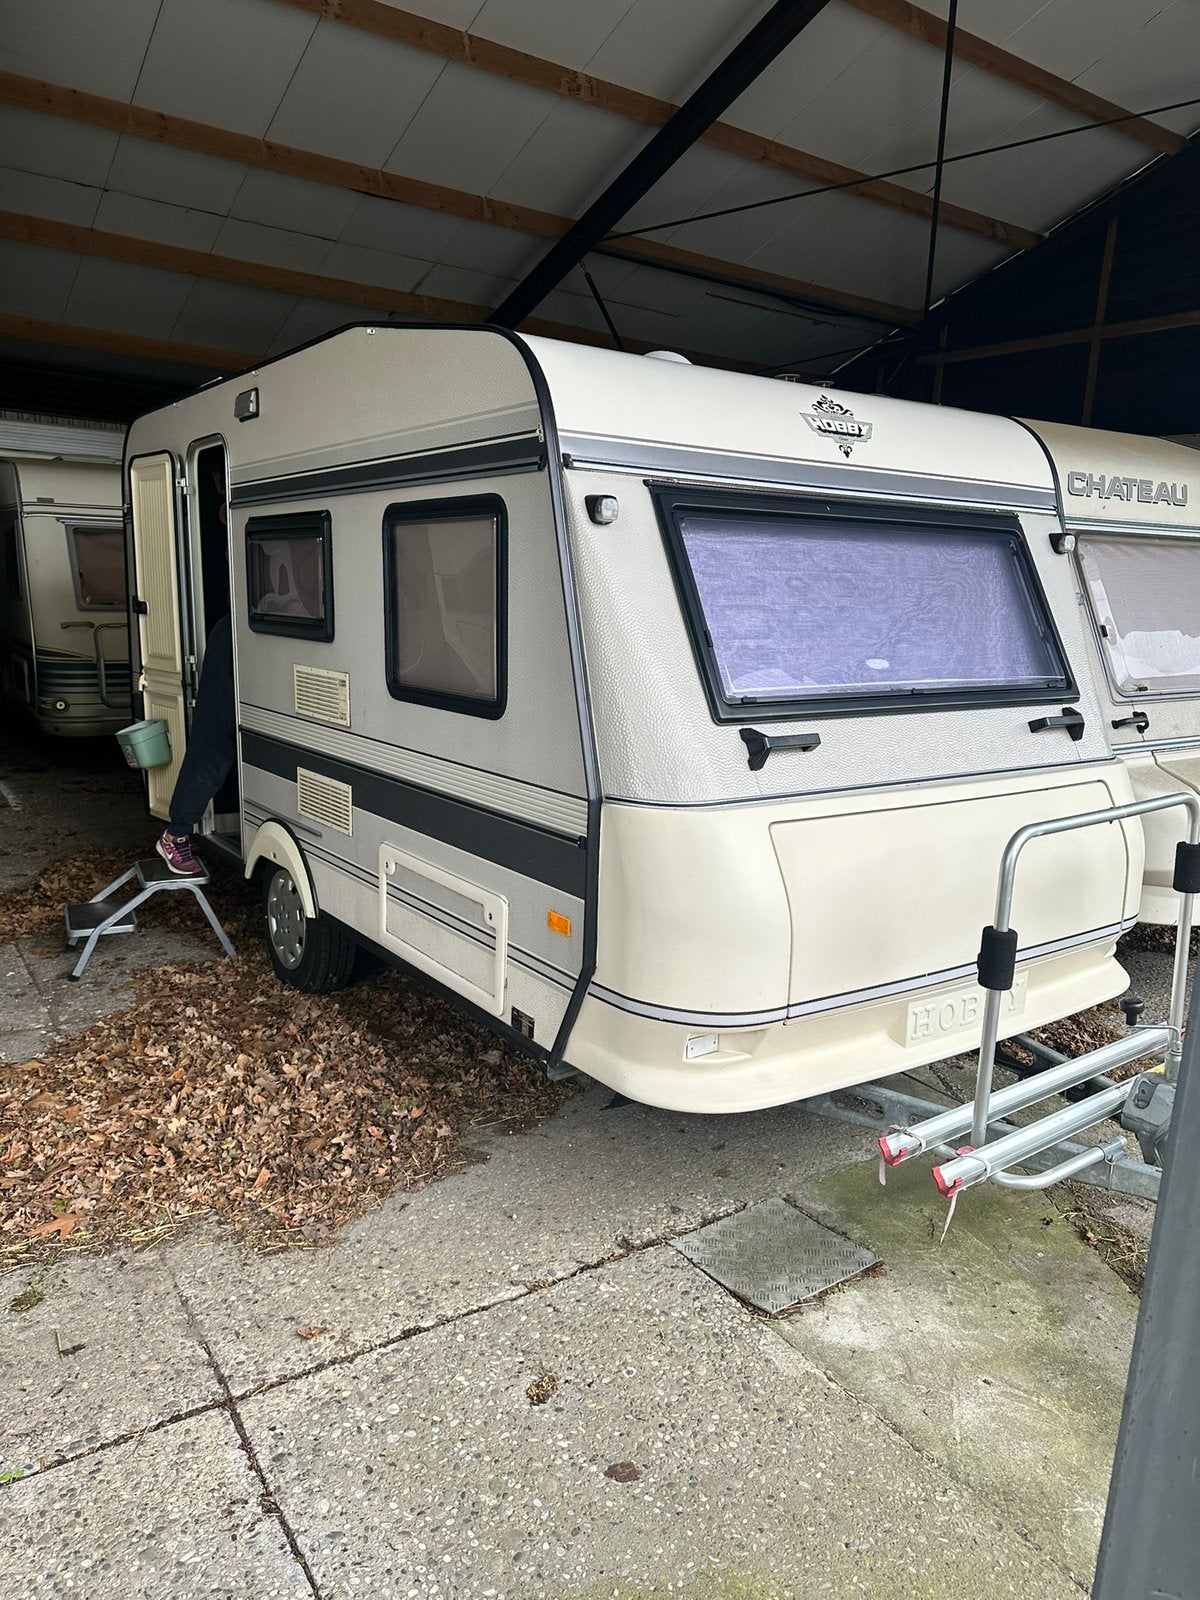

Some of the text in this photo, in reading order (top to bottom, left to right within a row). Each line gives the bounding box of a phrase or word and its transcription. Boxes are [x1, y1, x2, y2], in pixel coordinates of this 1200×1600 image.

[806, 415, 870, 437] HOBBY
[1067, 470, 1188, 507] CHATEAU
[910, 977, 1024, 1041] HOBY
